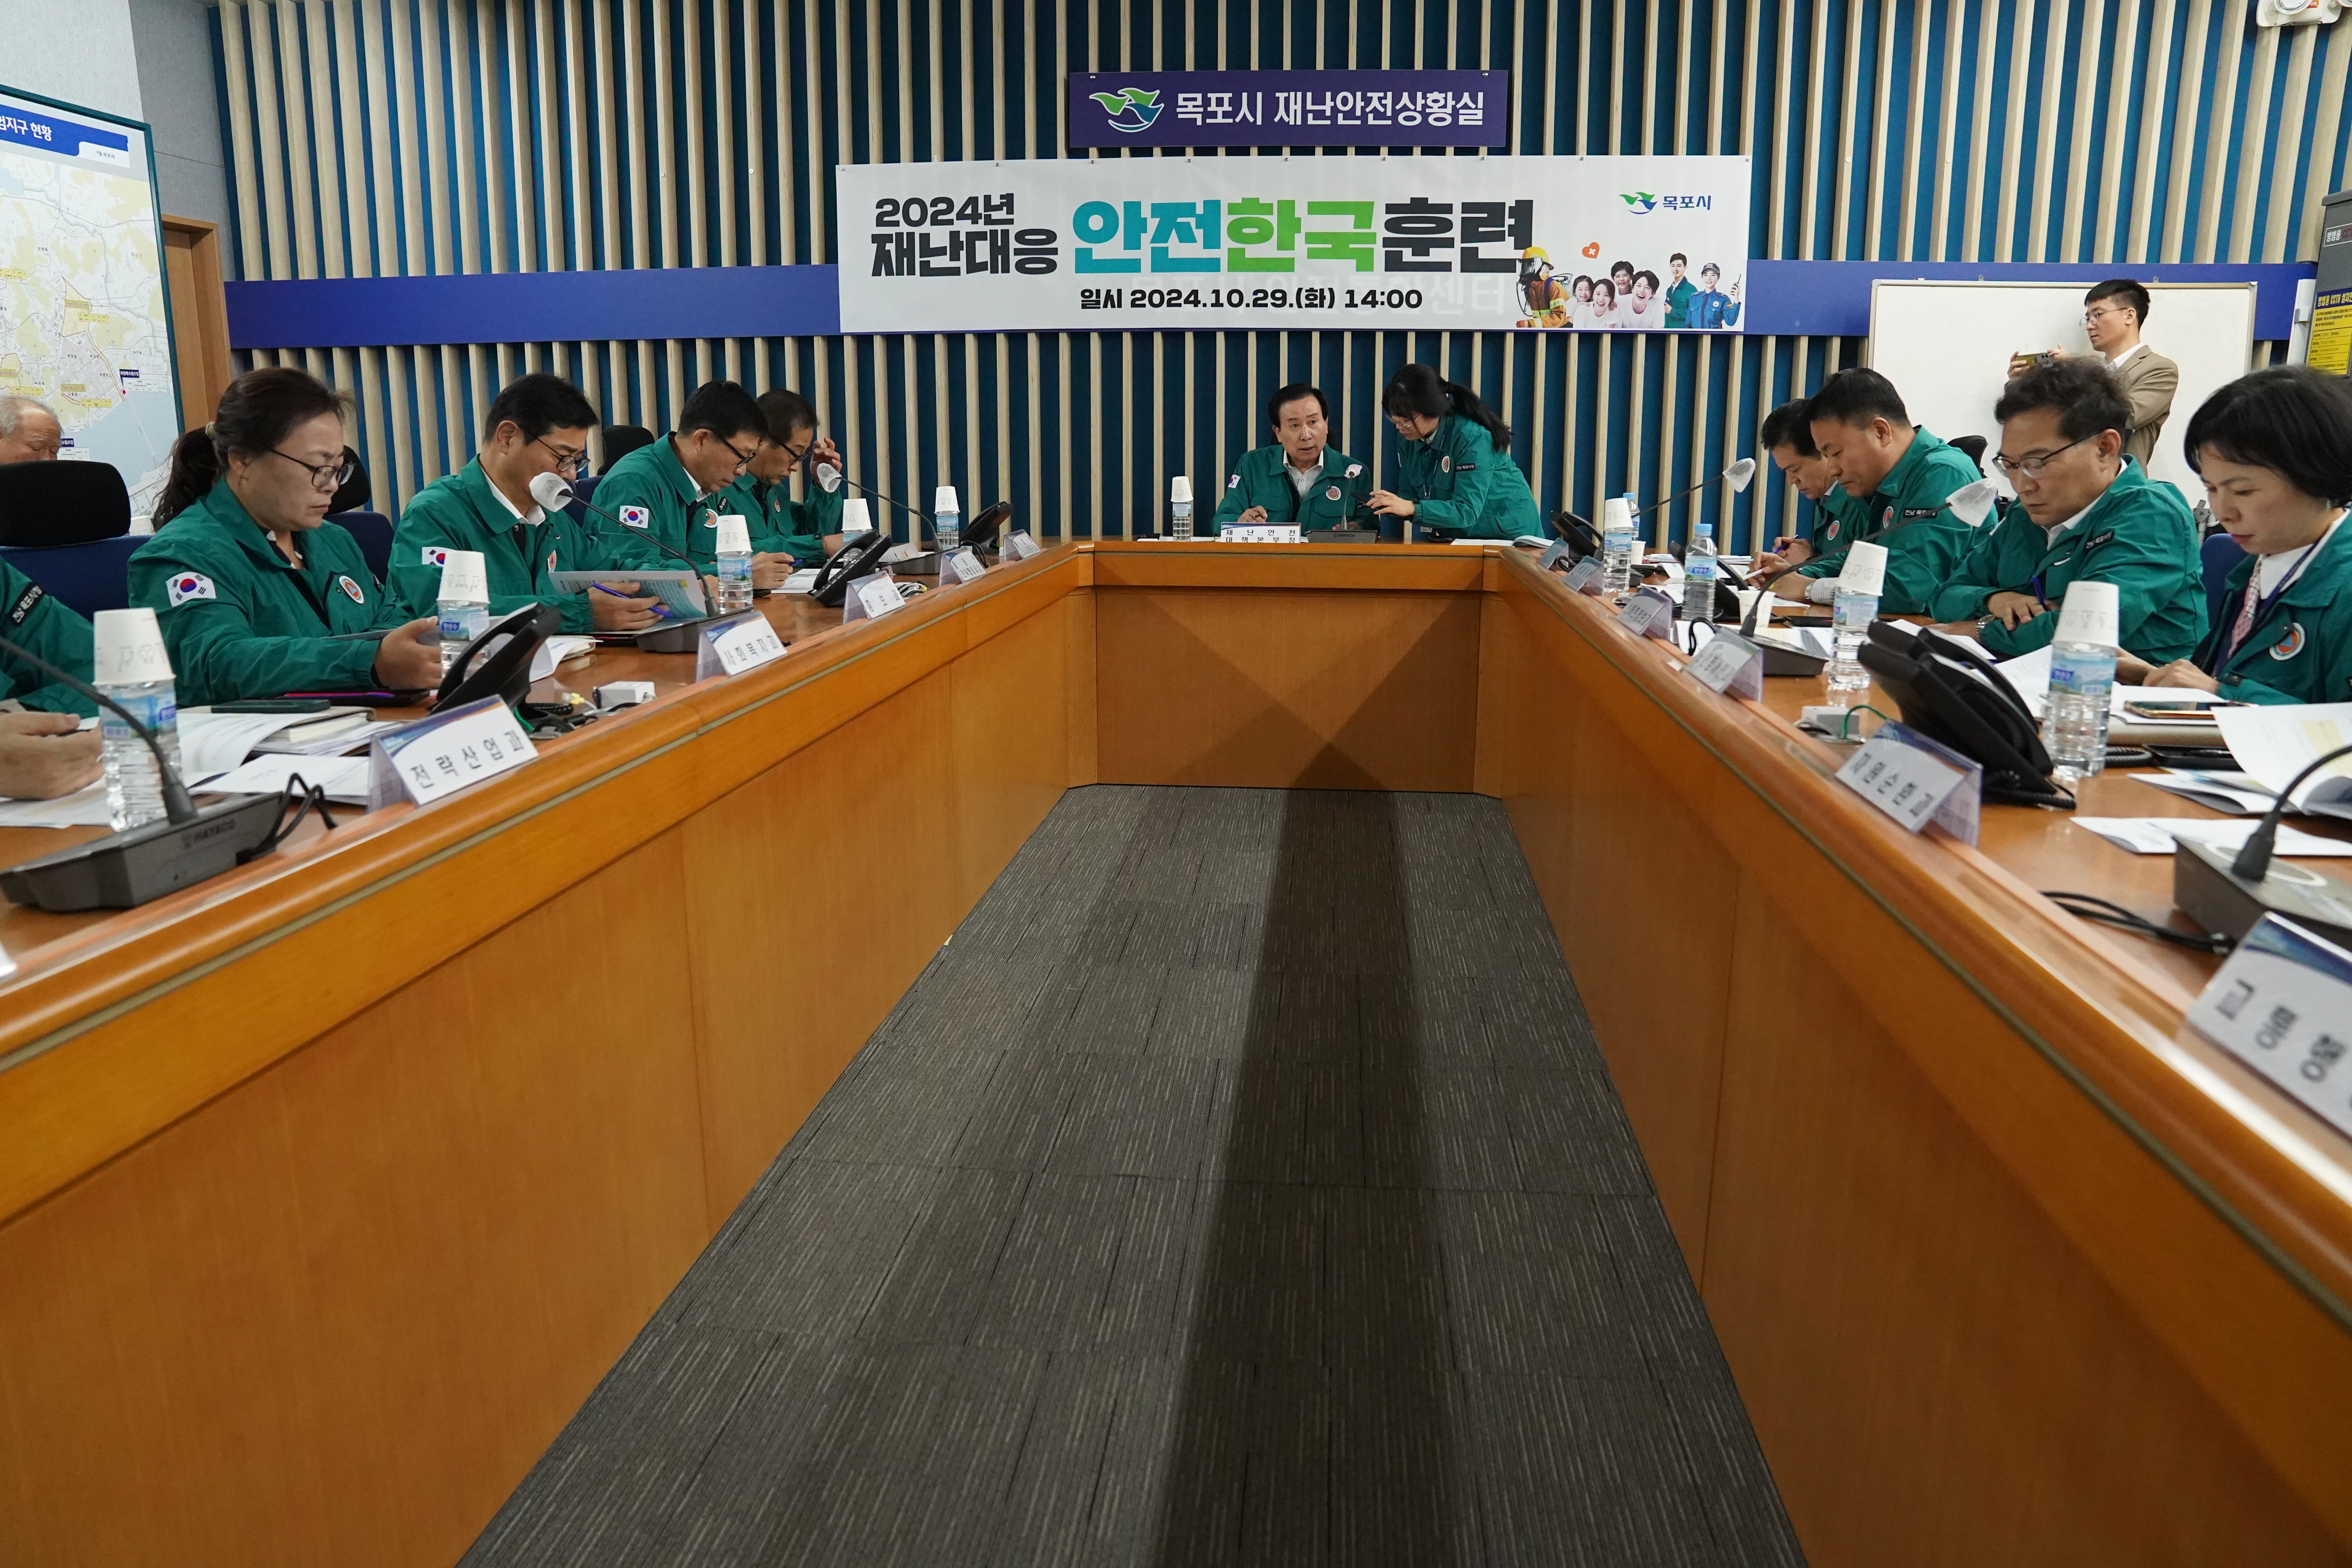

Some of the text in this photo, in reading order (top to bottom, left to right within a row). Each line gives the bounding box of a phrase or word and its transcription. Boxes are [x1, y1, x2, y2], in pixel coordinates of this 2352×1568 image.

[1176, 91, 1484, 127] 목포시 재난안전상황실
[30, 122, 52, 142] 현황
[875, 193, 1014, 227] 2024년
[1662, 195, 1711, 211] 목포시
[871, 228, 1058, 277] 재난대응
[1072, 197, 1534, 274] 안전한국훈련
[2326, 229, 2341, 243] 방범용
[1080, 287, 1422, 310] 일시 2024.10.29.(화) 14:00
[2318, 295, 2330, 307] 방범용
[2330, 294, 2341, 305] CCTV
[409, 729, 525, 789] 전략산업과
[2214, 978, 2352, 1111] 교통행
